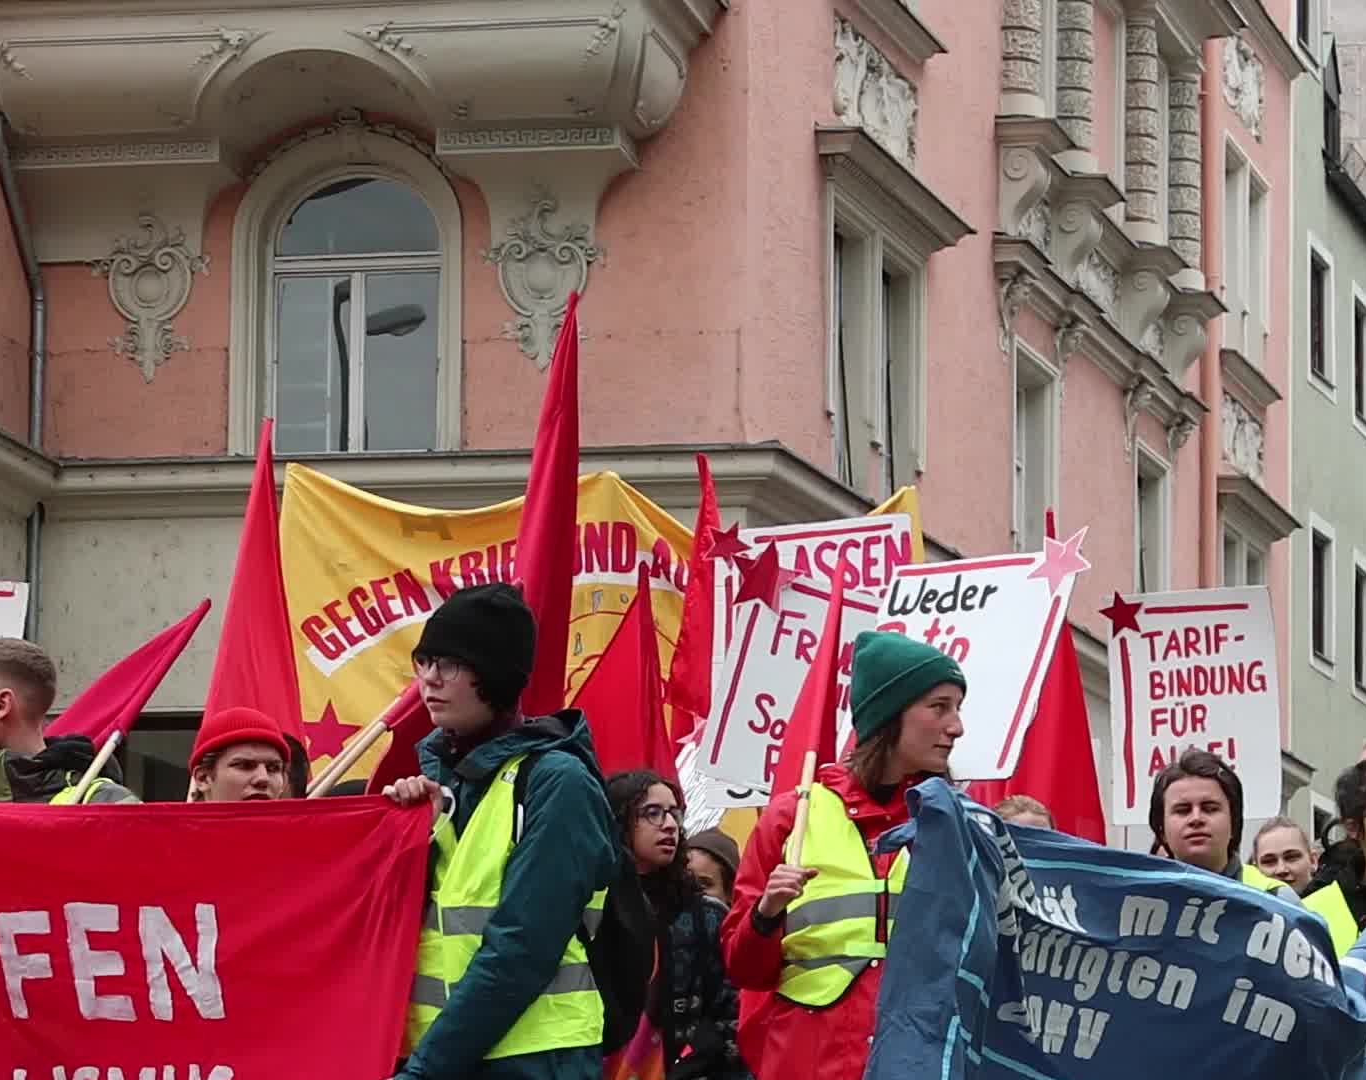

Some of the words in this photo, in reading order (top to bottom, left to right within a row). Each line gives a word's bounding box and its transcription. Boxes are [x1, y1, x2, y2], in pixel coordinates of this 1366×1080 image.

[791, 532, 912, 589] ASSEN
[300, 568, 433, 661] GEGEN
[429, 538, 519, 603] KRIE
[887, 574, 999, 617] Weder
[1141, 624, 1245, 662] TARIF-
[1149, 660, 1268, 700] BINDUNG
[1151, 701, 1207, 737] FÜR
[1119, 895, 1229, 945] mit
[1221, 977, 1297, 1042] im
